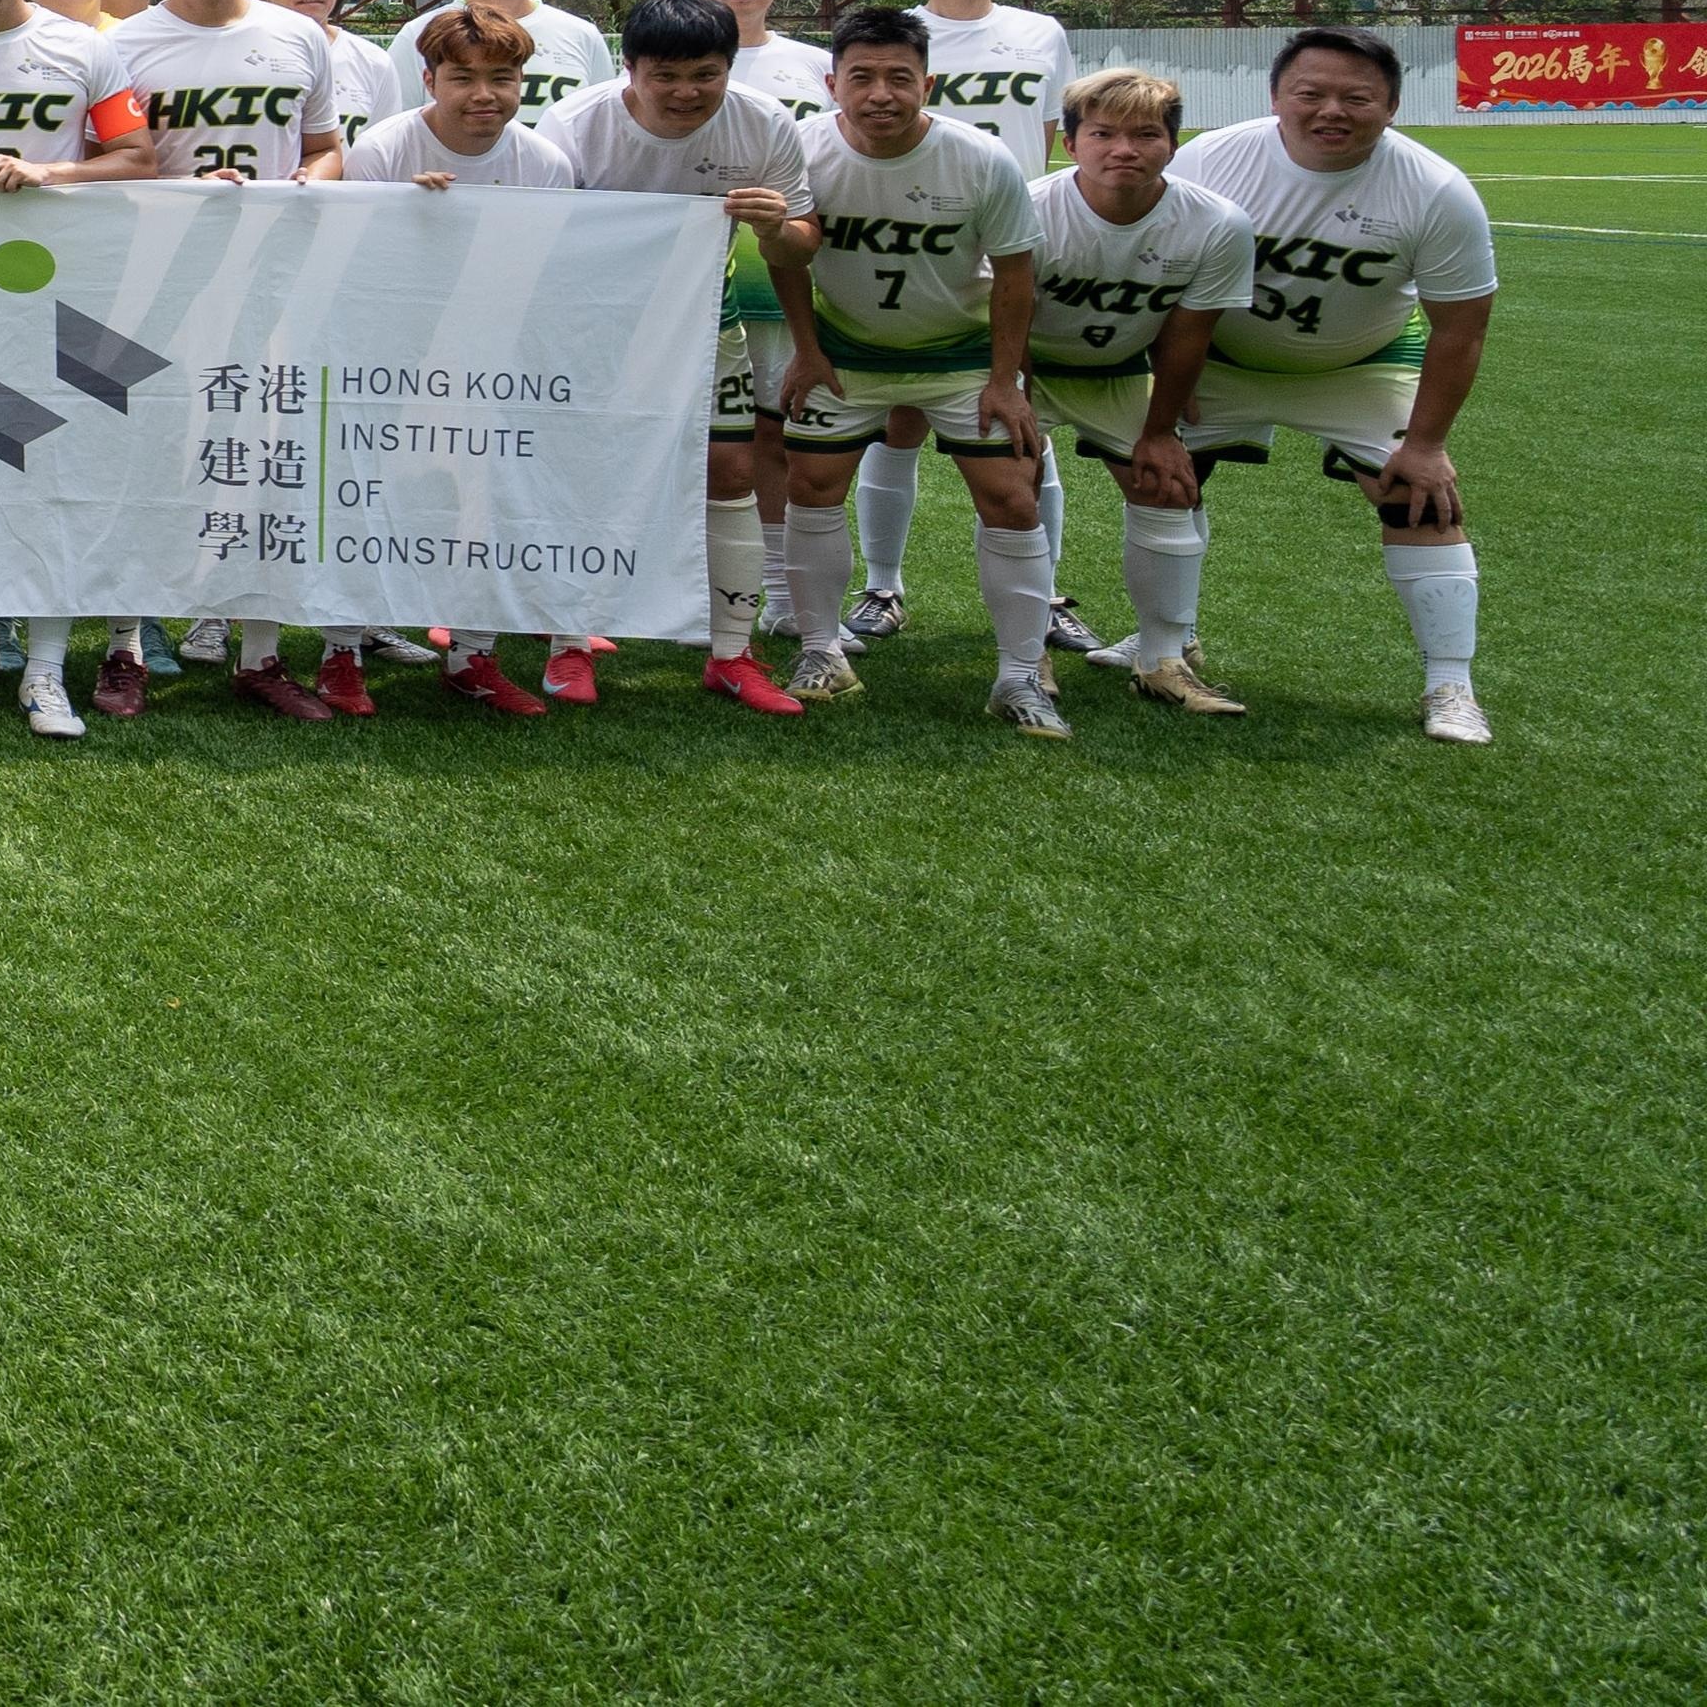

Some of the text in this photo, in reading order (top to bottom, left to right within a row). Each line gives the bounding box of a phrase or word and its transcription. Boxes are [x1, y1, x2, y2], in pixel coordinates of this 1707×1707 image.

[1490, 43, 1630, 84] 2026馬年
[148, 86, 303, 131] HKIC
[924, 71, 1043, 106] KIC
[818, 214, 964, 256] HKIC
[875, 269, 905, 311] 7
[197, 363, 308, 415] 香港
[342, 366, 572, 403] HONG KONG
[340, 422, 535, 458] INSTITUTE
[197, 437, 307, 490] 建造
[337, 479, 384, 508] OF
[197, 510, 307, 565] 學院
[335, 534, 637, 577] CONSTRUCTION
[714, 586, 761, 609] Y-3
